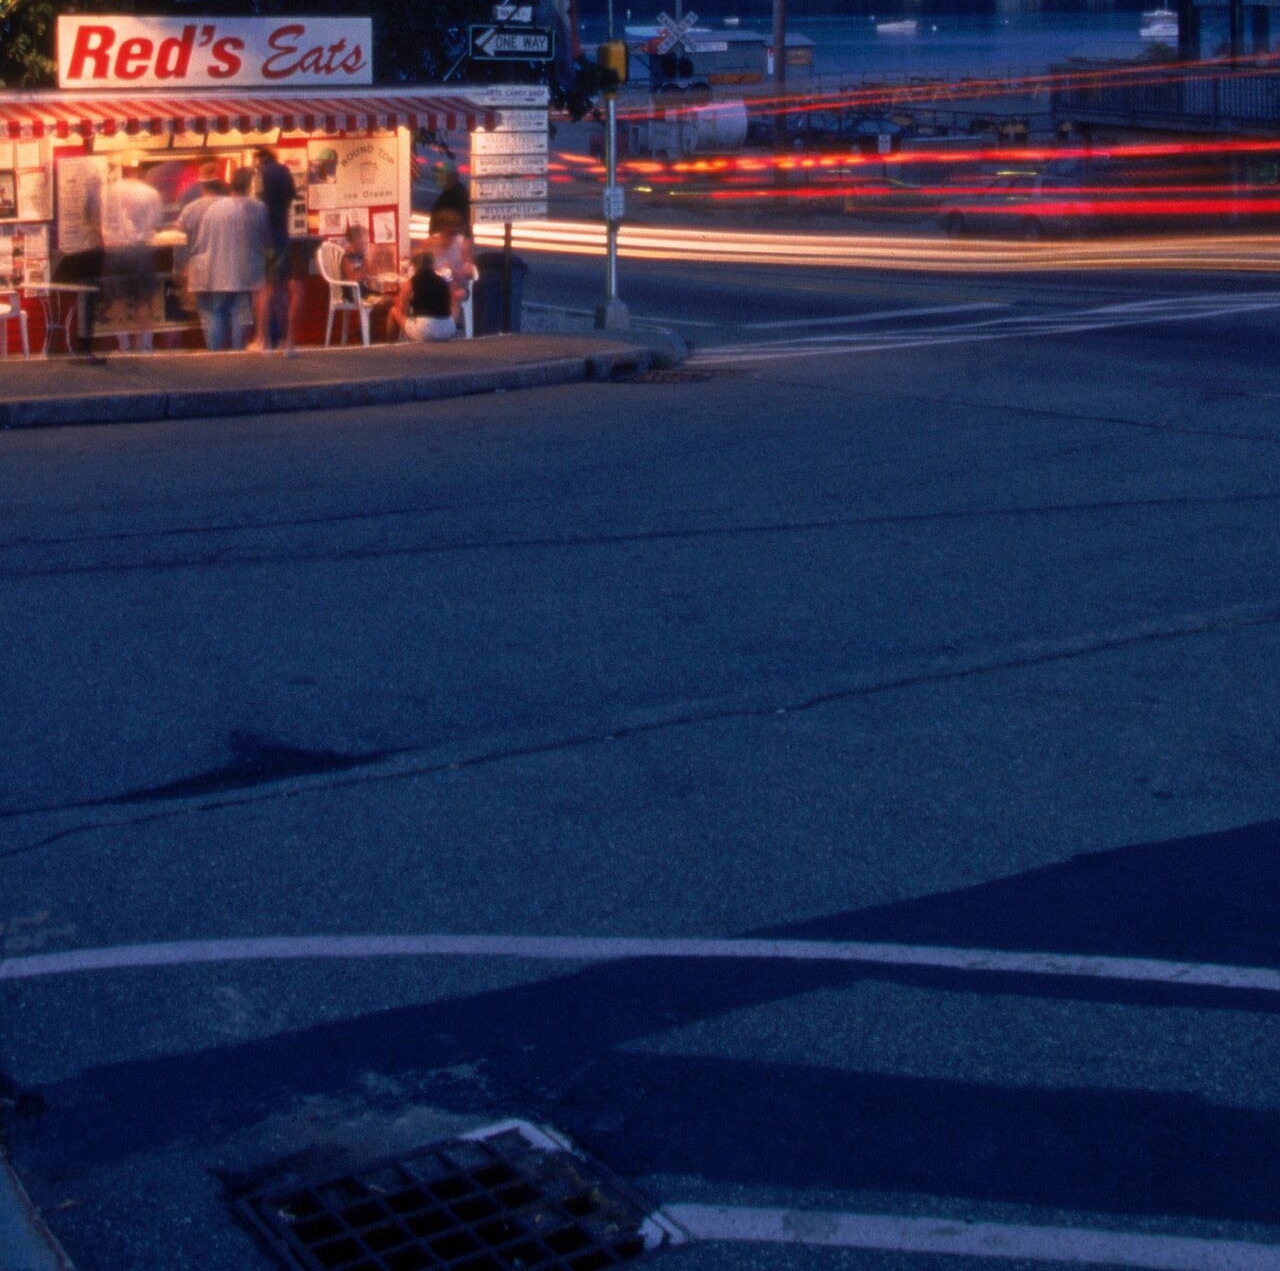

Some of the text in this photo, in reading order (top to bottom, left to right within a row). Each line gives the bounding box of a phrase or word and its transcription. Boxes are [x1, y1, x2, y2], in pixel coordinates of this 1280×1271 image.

[495, 35, 546, 49] ONE WAY
[66, 23, 368, 80] Red's Eats
[341, 144, 395, 167] ROUND TOP
[362, 190, 393, 199] Cream
